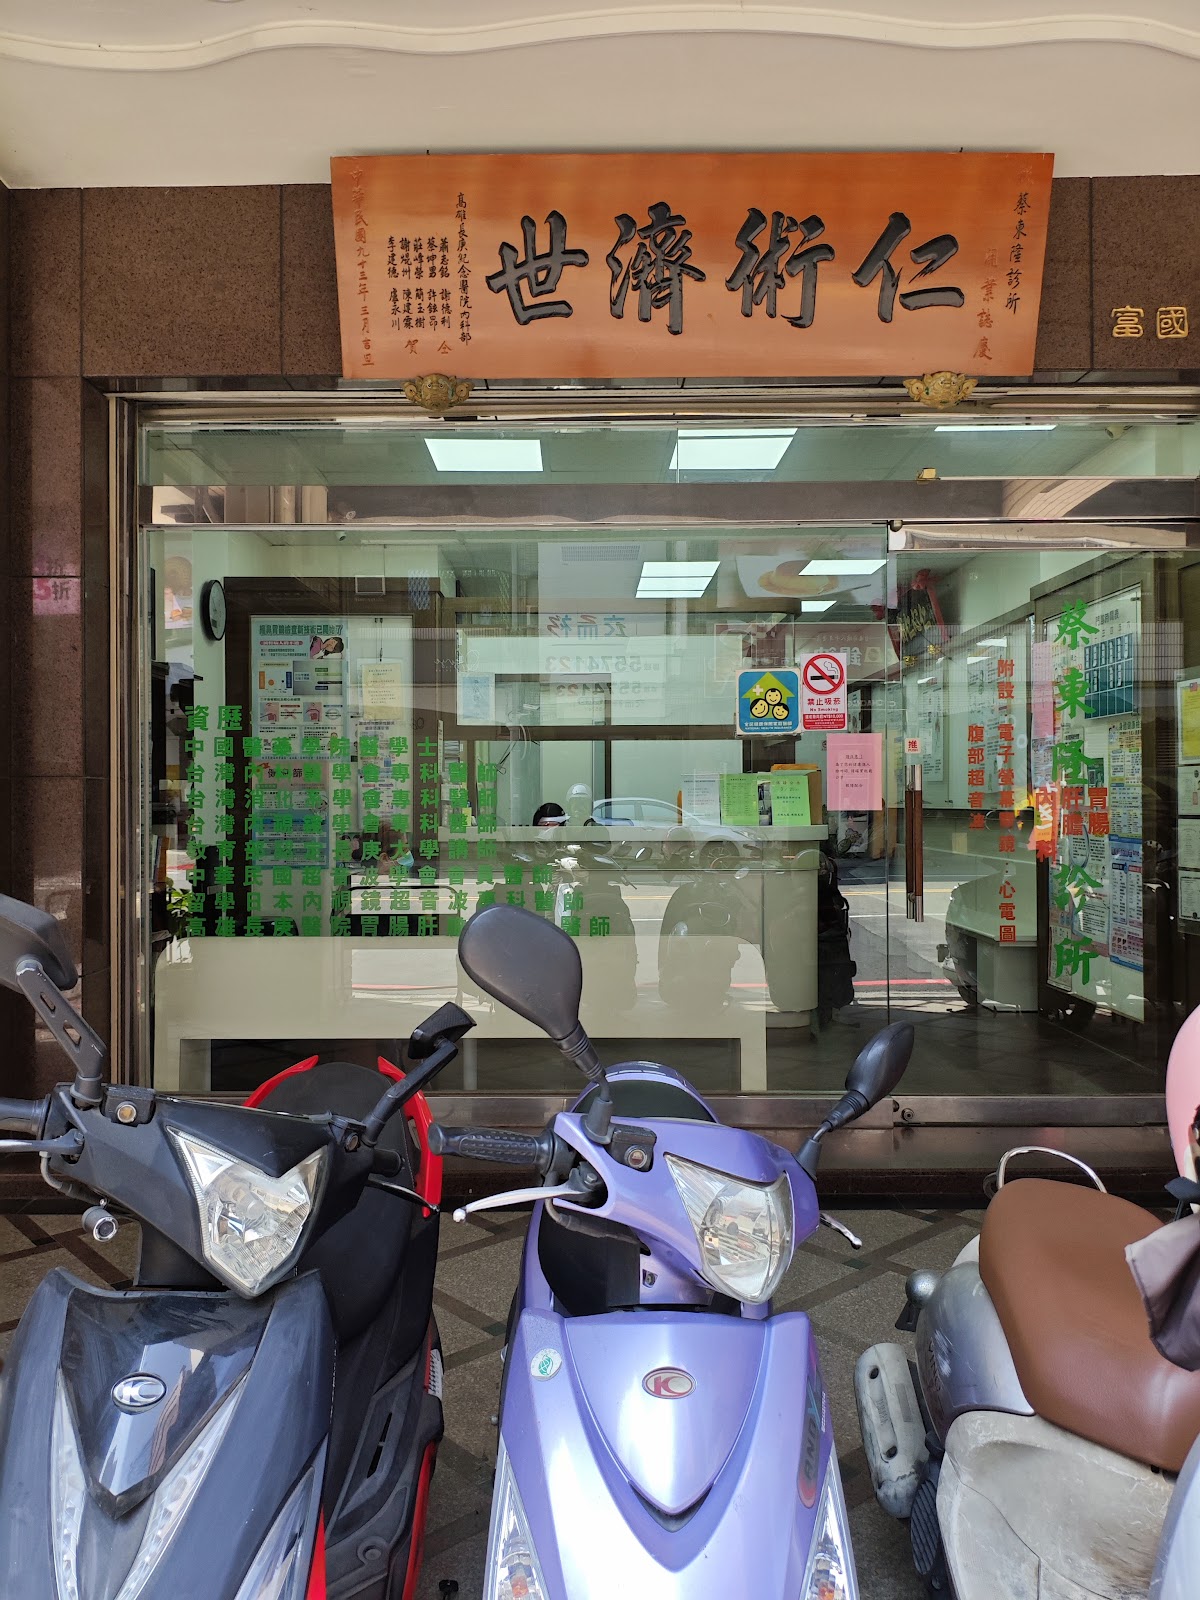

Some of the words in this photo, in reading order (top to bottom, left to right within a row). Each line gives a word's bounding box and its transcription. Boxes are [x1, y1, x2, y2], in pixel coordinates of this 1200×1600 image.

[807, 697, 841, 706] 禁止吸菸
[184, 705, 243, 731] 資歷
[184, 736, 438, 758] 中國醫藥學院醫學士
[908, 740, 918, 749] 推
[185, 762, 498, 783] 台灣內科醫學會專科醫師
[186, 788, 498, 809] 台灣消化系學會專科醫師
[1051, 598, 1103, 986] 蔡東隆診所
[1088, 787, 1110, 836] 胃腸
[186, 813, 498, 835] 台灣內視鏡學會專科醫師
[186, 865, 554, 887] 中華民國超音波學會會員醫師
